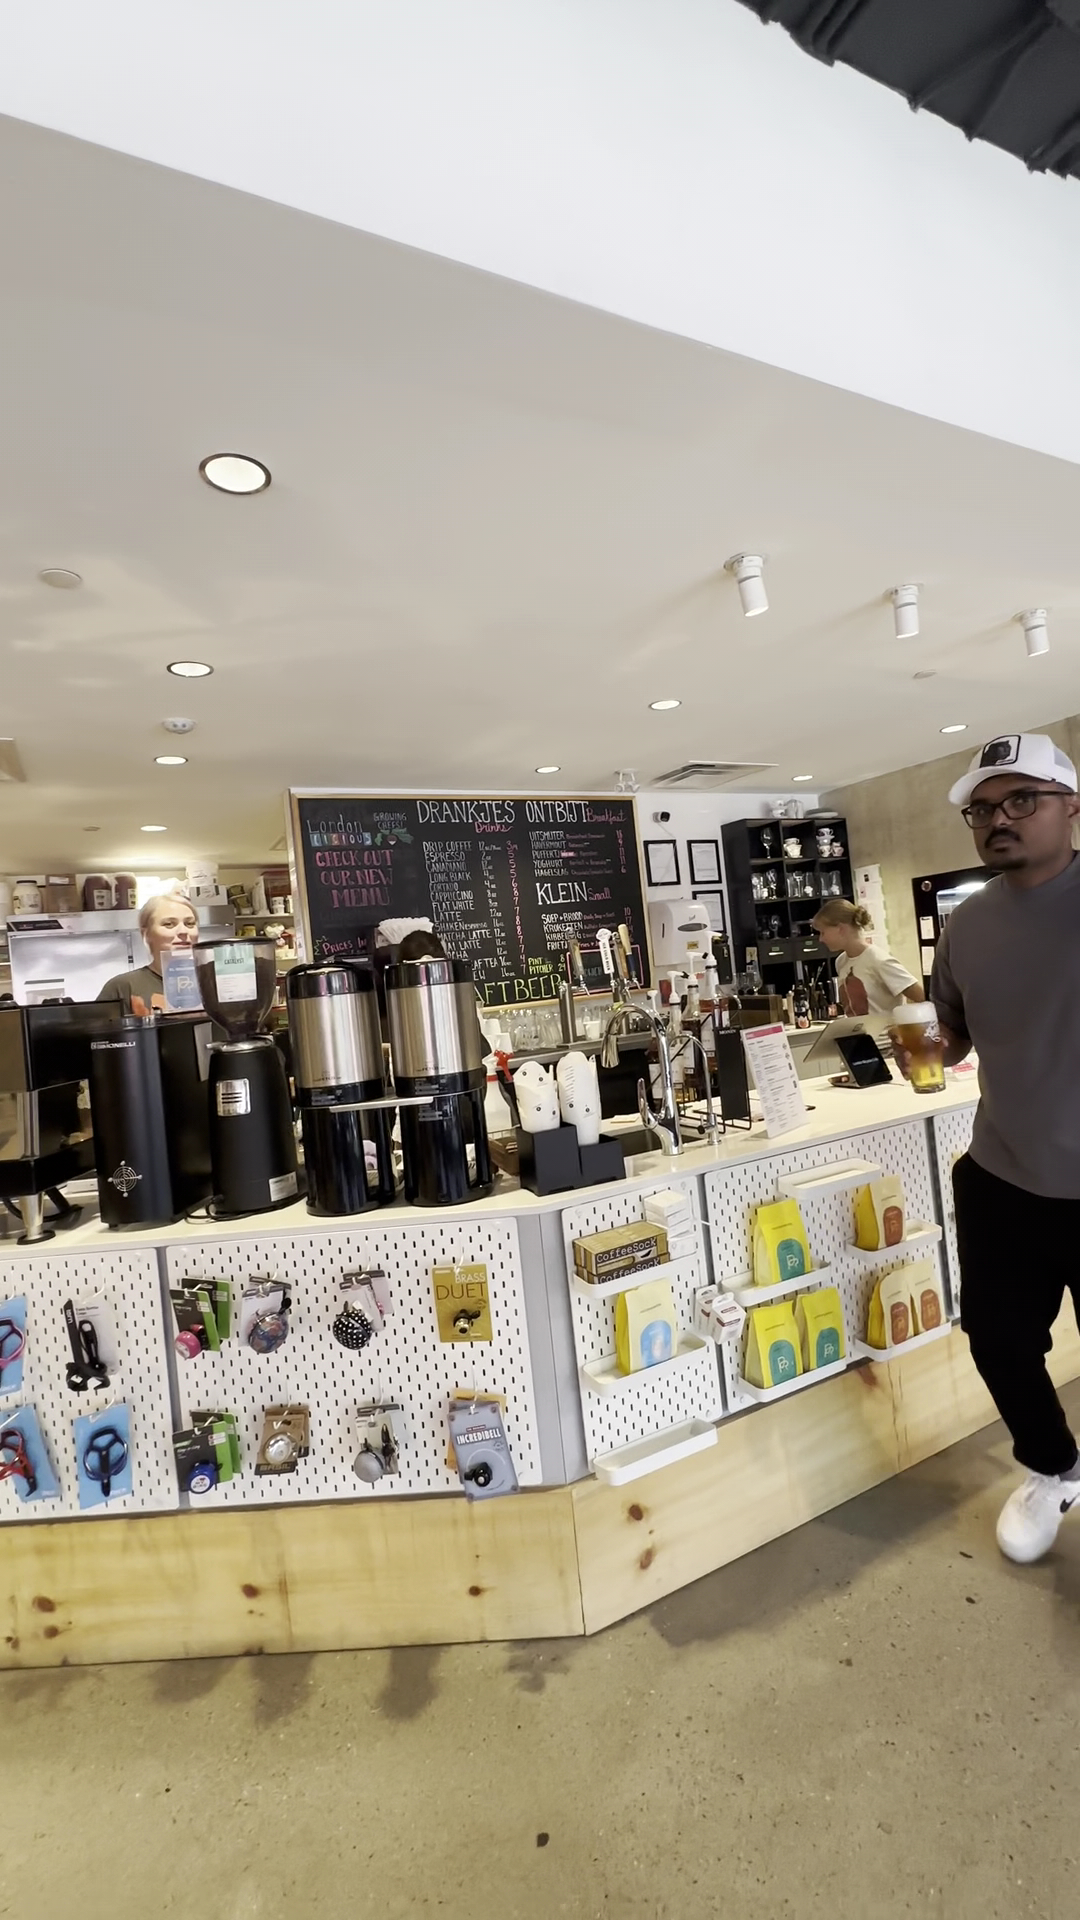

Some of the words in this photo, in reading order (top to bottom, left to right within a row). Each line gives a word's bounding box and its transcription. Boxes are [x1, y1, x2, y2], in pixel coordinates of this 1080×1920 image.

[416, 800, 515, 823] DRANKJES
[525, 801, 589, 823] ONTBIJT
[306, 813, 363, 834] London
[474, 821, 514, 834] Drinks
[422, 841, 444, 853] DRIP
[445, 840, 473, 852] COFFEE
[315, 849, 361, 868] CHECK
[363, 849, 394, 867] OUT
[424, 851, 466, 863] ESPRESSO
[425, 861, 467, 873] CANADIANO
[508, 859, 517, 869] 5
[320, 869, 351, 887] OUR
[356, 867, 393, 886] NEW
[429, 872, 449, 884] LONG
[449, 871, 472, 882] BLACK
[510, 869, 517, 879] 5
[429, 881, 459, 894] CORTADO
[511, 878, 518, 888] 6
[535, 881, 588, 906] KLEIN
[587, 887, 613, 901] Small
[331, 886, 391, 909] MENU
[430, 890, 474, 903] CAPPUCCINO
[513, 887, 519, 897] 8
[431, 901, 451, 913] FLAT
[452, 900, 475, 911] WHITE
[513, 896, 519, 906] 7
[432, 911, 463, 923] LATTE
[514, 906, 520, 916] 7
[541, 913, 559, 925] SOEP
[563, 911, 583, 923] BROOD
[434, 921, 466, 932] SHAKEN
[515, 915, 521, 926] 8
[436, 930, 466, 942] MATCHA
[468, 929, 493, 940] LATTE
[516, 925, 522, 935] 8
[322, 940, 353, 955] PRICES
[458, 939, 483, 951] LATTE
[518, 936, 524, 944] 7
[519, 945, 525, 953] 7
[224, 957, 245, 965] CATALYST
[483, 957, 498, 968] TEA
[528, 956, 543, 965] PINT
[520, 965, 526, 975] 7
[528, 963, 554, 975] PITCHER
[557, 962, 566, 972] 24
[455, 1272, 486, 1284] BRASS
[436, 1282, 487, 1300] DUET
[456, 1428, 502, 1445] INCREDIBELL
